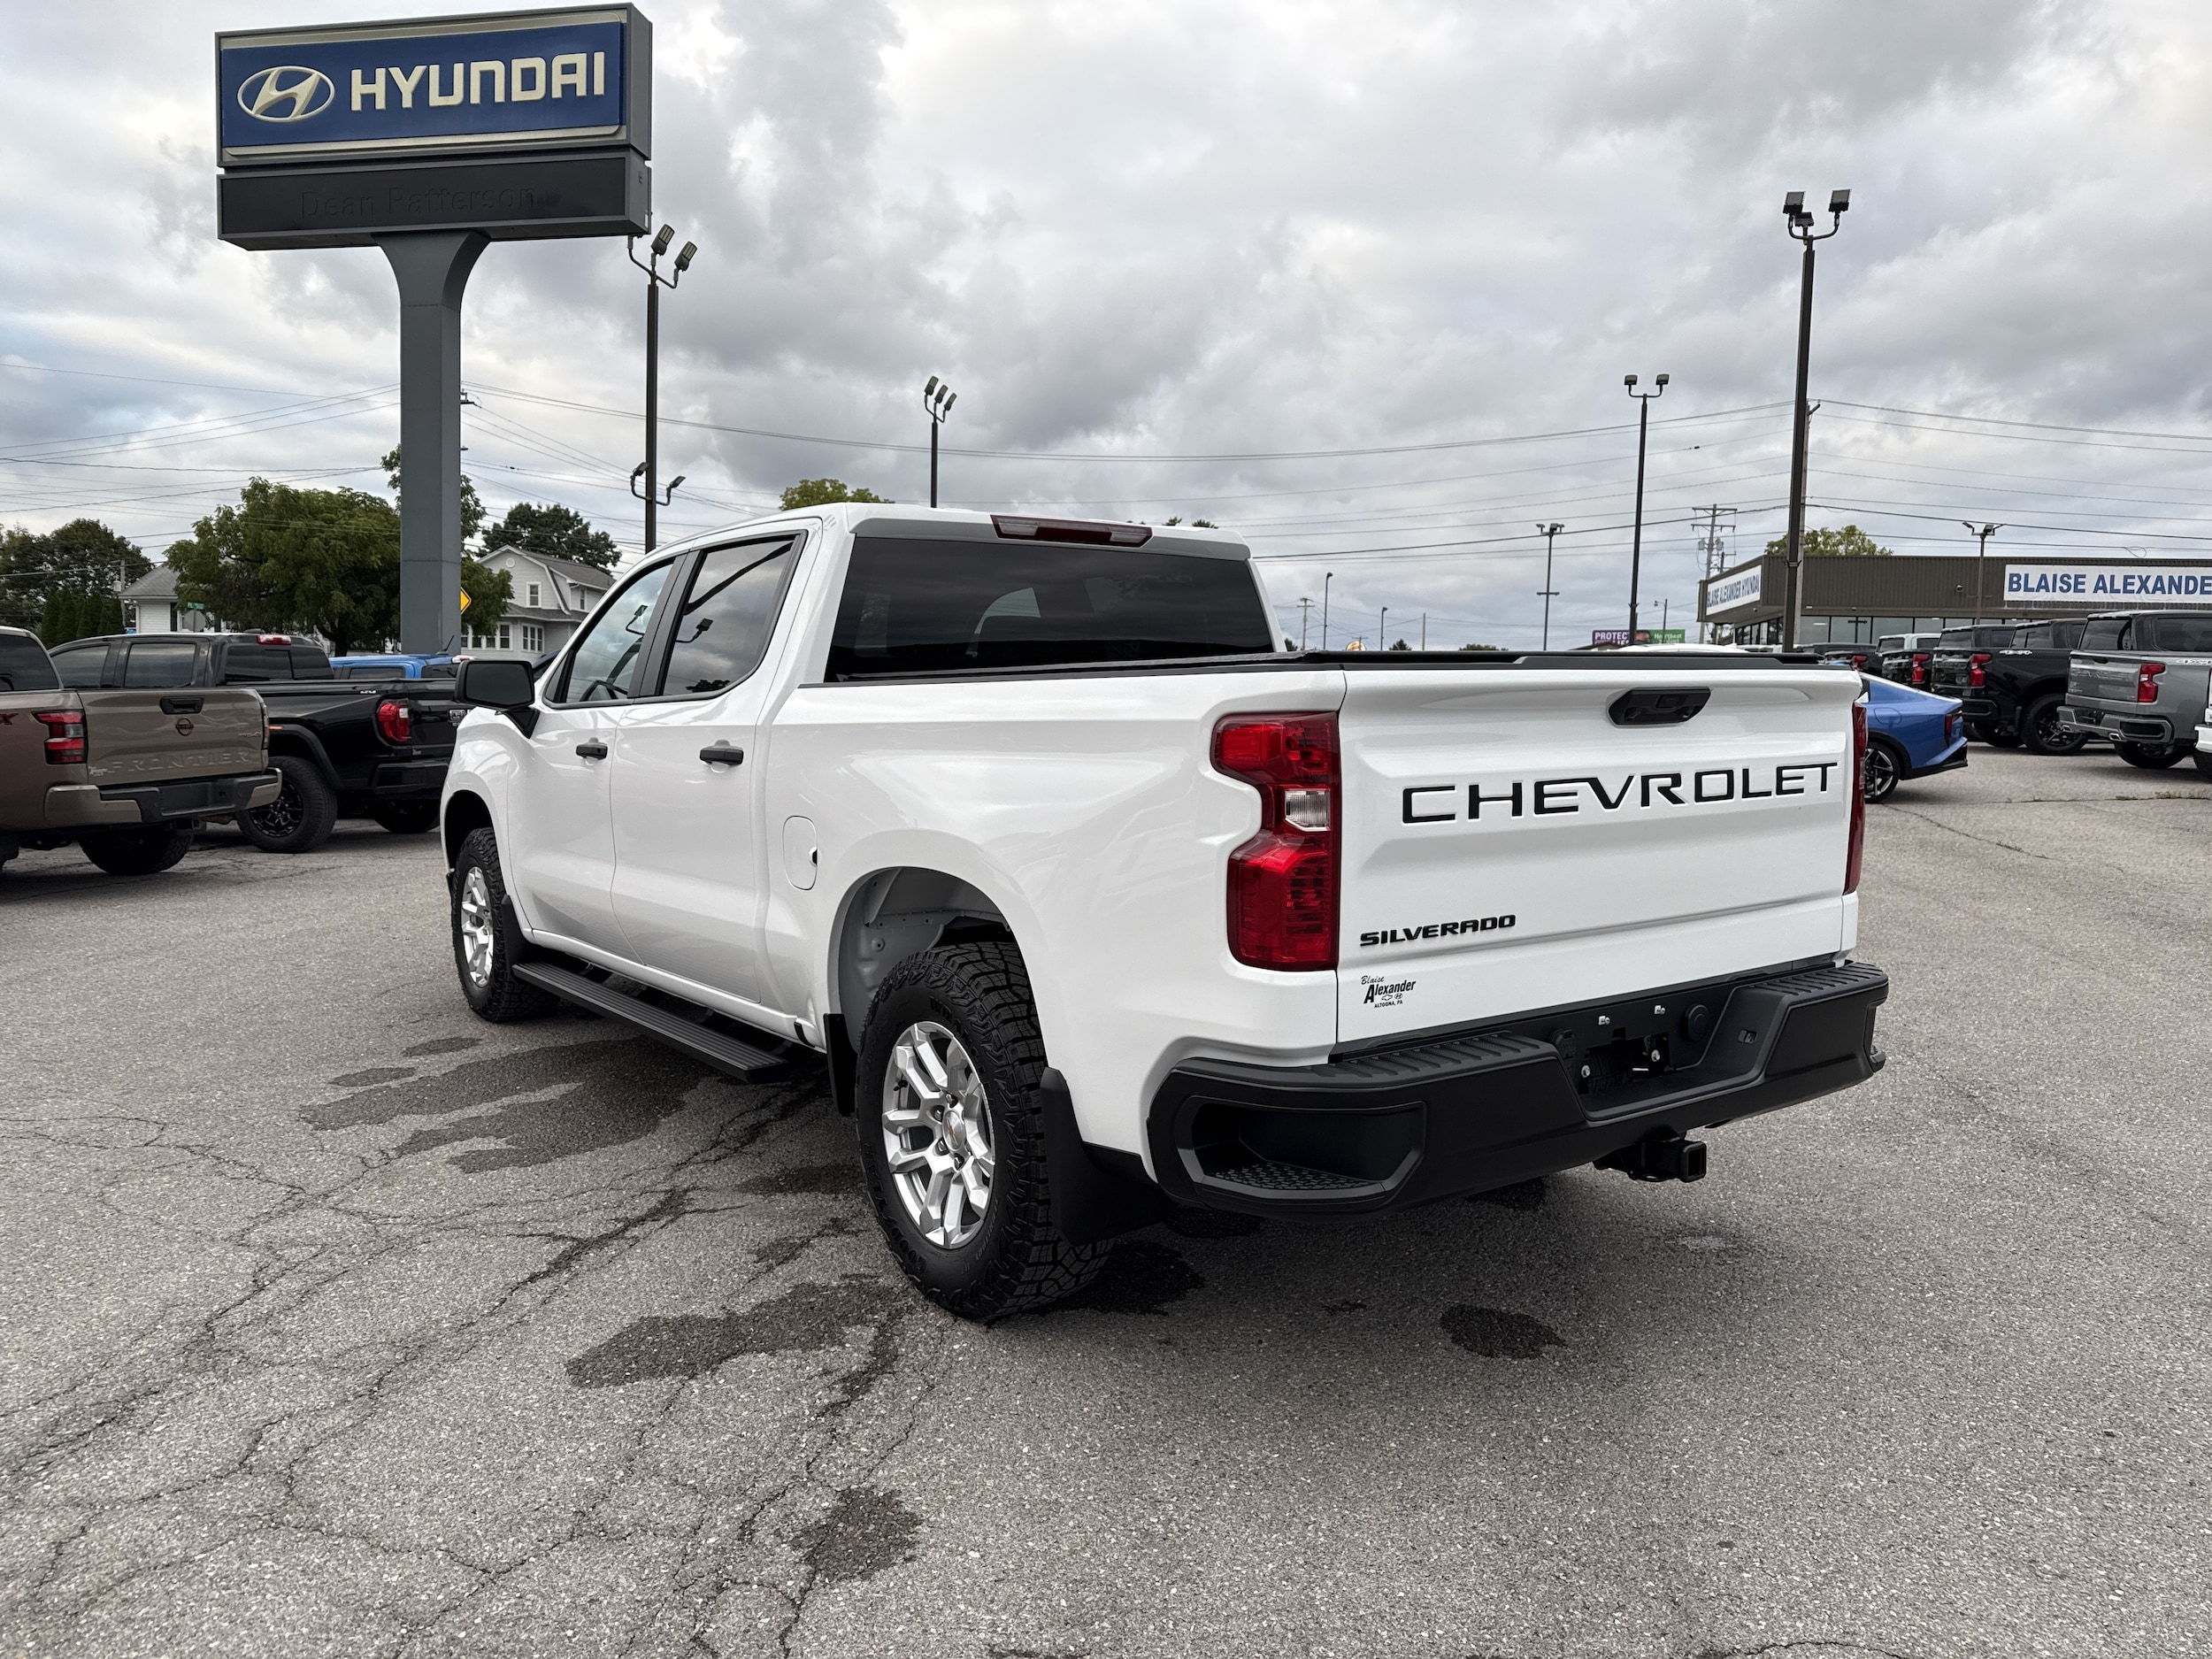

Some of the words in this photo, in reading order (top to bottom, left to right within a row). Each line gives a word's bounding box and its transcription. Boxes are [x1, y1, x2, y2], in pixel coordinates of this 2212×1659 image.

[351, 51, 605, 111] HYUNDAI
[302, 191, 374, 219] Dean
[388, 186, 535, 215] Patterson
[2008, 572, 2086, 593] BLAISE
[2093, 574, 2212, 595] ALEXANDE
[1595, 631, 1630, 640] PROTEC
[107, 752, 250, 774] FRONTIER
[1402, 762, 1838, 824] CHEVROLET
[1360, 914, 1516, 947] SILVERADO
[1361, 975, 1385, 985] Blaise
[1363, 979, 1417, 1004] Alexander
